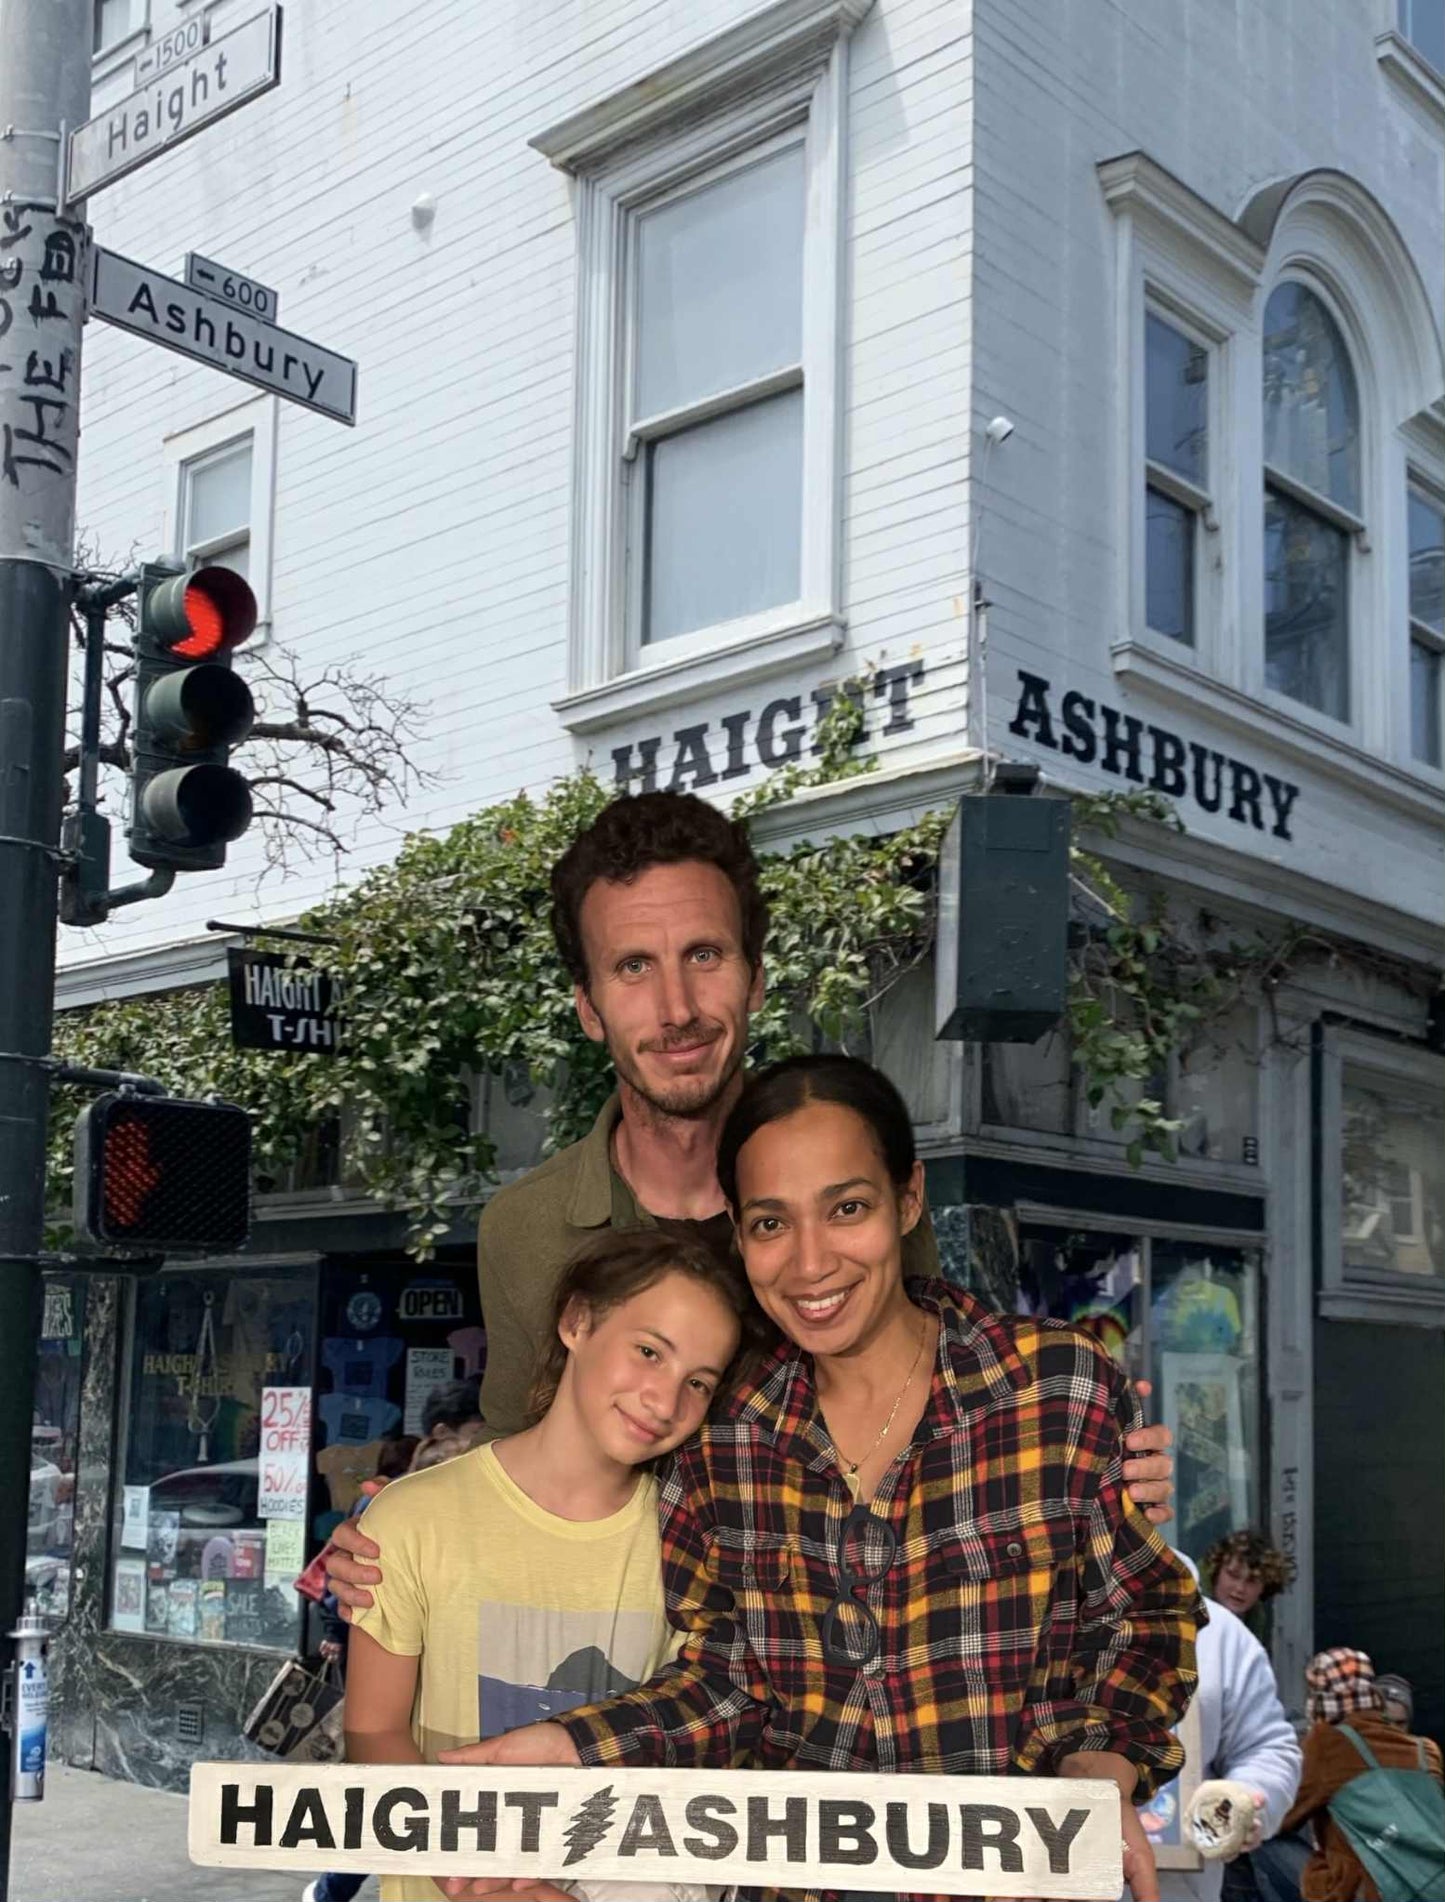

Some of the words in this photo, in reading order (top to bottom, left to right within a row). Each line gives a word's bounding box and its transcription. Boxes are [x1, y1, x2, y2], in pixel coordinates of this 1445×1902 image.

[156, 22, 199, 69] 1500
[106, 53, 229, 158] Haight
[222, 276, 270, 313] 600
[128, 282, 326, 400] Ashbury
[1008, 670, 1301, 842] ASHBURY
[404, 1290, 459, 1317] OPEN
[266, 1430, 299, 1451] OFF
[220, 1784, 559, 1852] HAIGHT
[617, 1794, 1091, 1874] ASHBURY
